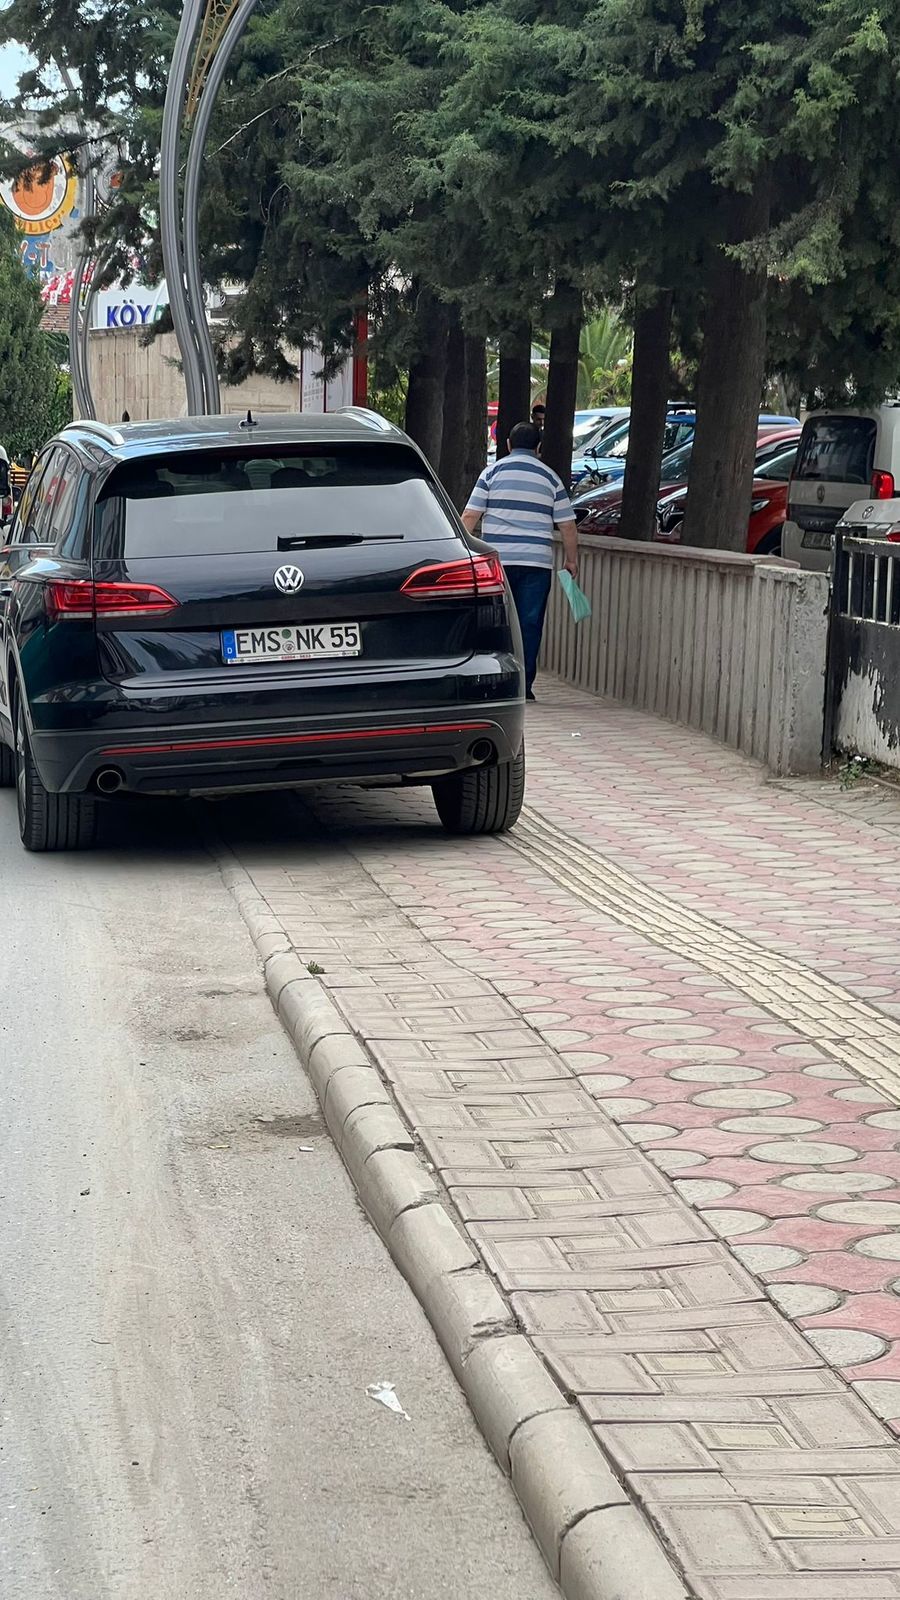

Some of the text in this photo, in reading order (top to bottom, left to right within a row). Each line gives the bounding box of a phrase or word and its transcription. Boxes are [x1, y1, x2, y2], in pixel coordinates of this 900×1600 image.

[236, 626, 358, 654] EMS NK 55
